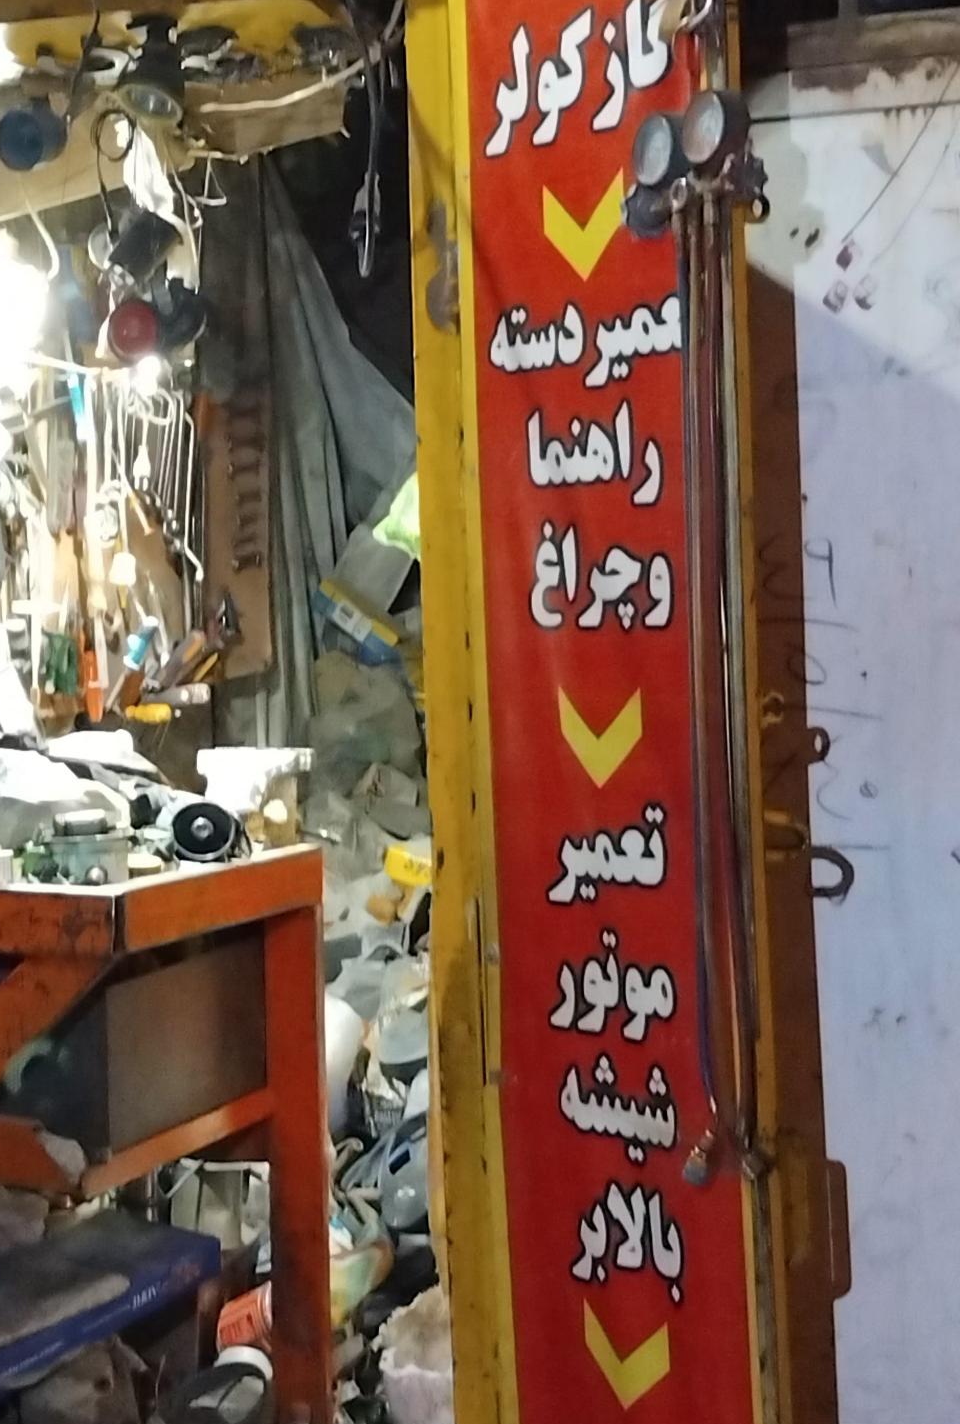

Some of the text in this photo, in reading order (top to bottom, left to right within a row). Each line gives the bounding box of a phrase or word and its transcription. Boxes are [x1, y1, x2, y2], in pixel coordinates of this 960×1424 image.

[485, 7, 593, 157] کولر
[490, 295, 682, 387] عمیر دسته
[528, 400, 661, 505] راهنما
[548, 805, 665, 904] تعمیر
[550, 929, 675, 1041] موتور
[560, 1055, 676, 1162] شیشه
[572, 1182, 682, 1303] بالابر
